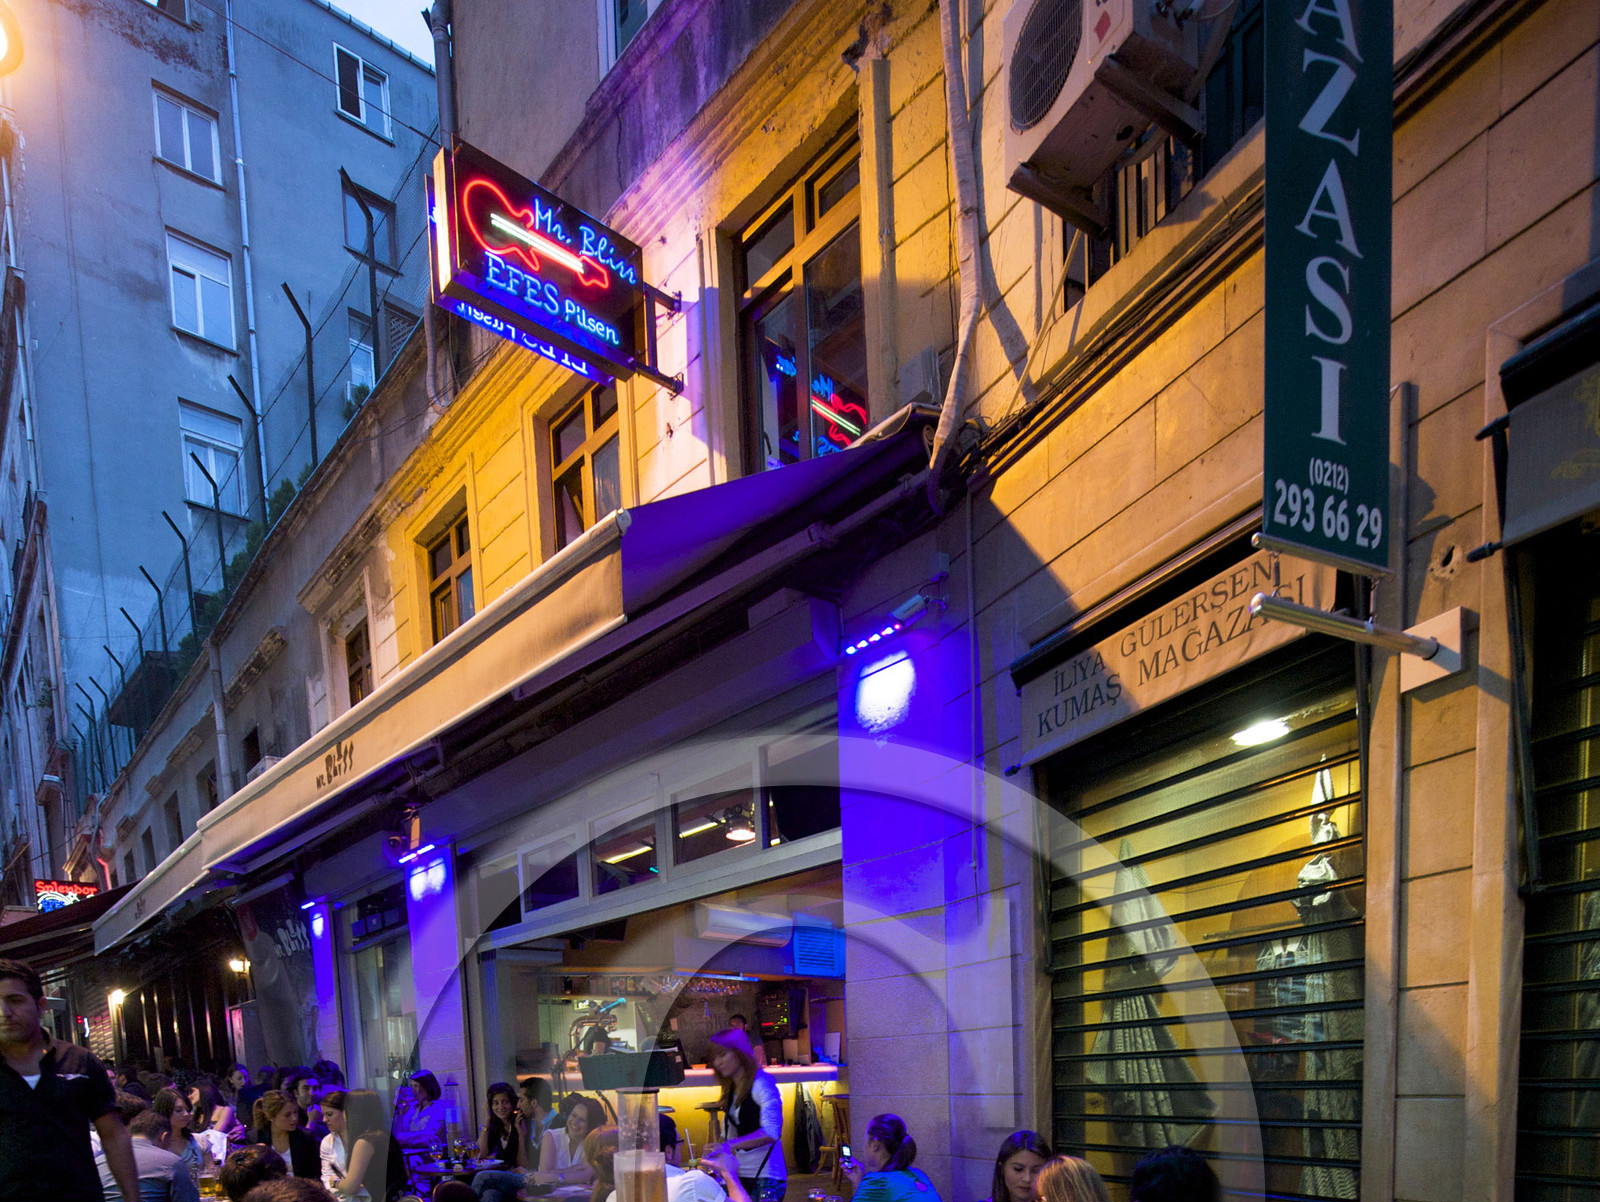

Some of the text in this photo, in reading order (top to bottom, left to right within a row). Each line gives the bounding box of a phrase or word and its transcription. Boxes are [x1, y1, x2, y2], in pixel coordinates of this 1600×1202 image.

[484, 251, 560, 314] EFES
[564, 299, 620, 345] Pilsen
[1309, 457, 1349, 495] (0212)
[1273, 478, 1382, 550] 293 66 29
[1037, 672, 1122, 738] KUMAŞ
